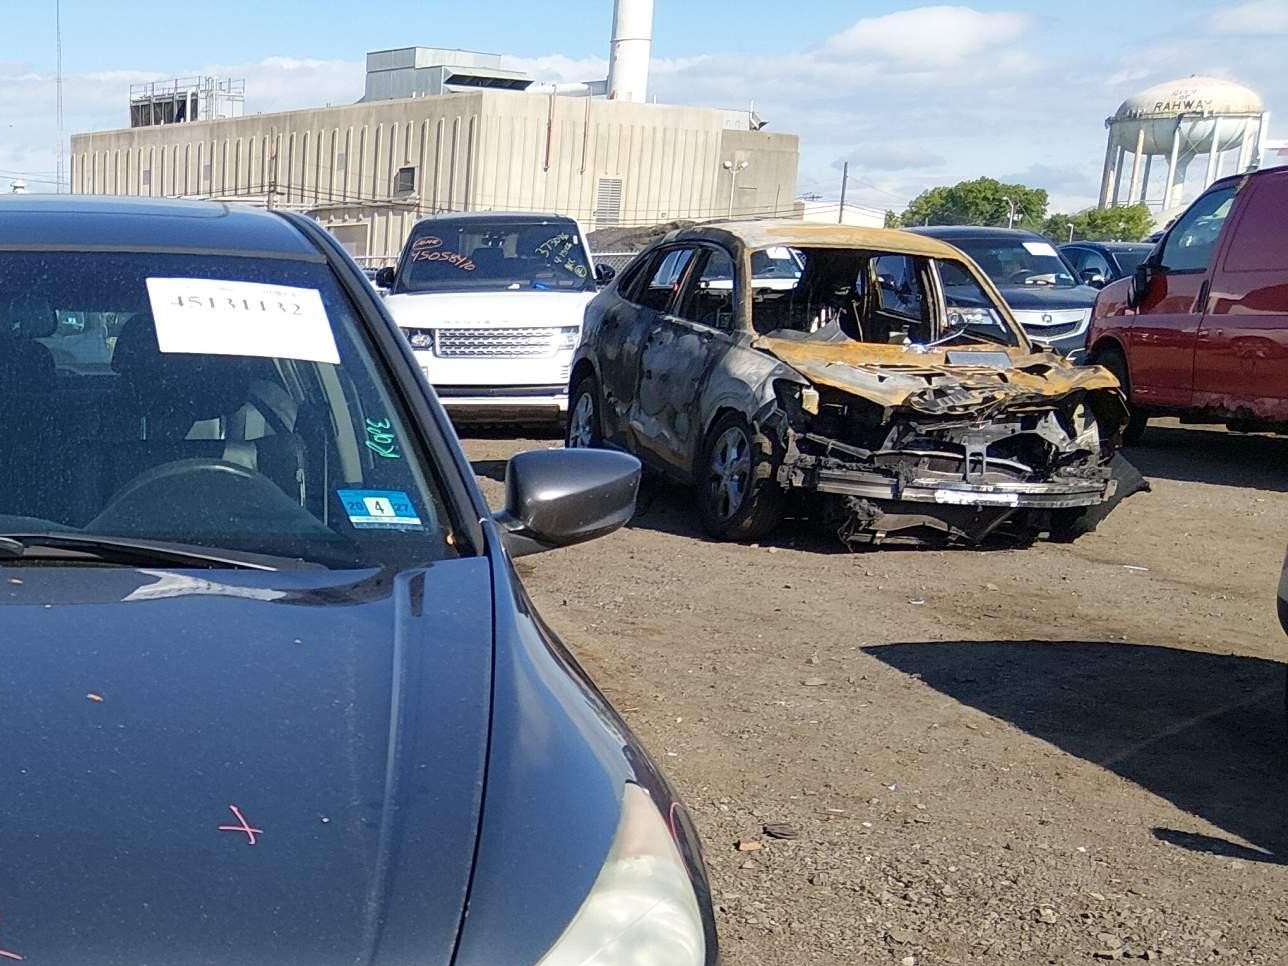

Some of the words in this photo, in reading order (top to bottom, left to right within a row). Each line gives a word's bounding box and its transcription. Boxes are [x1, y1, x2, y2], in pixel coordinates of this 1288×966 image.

[1153, 100, 1214, 113] RAHWAY
[170, 296, 304, 316] 45131132
[374, 500, 385, 515] 4
